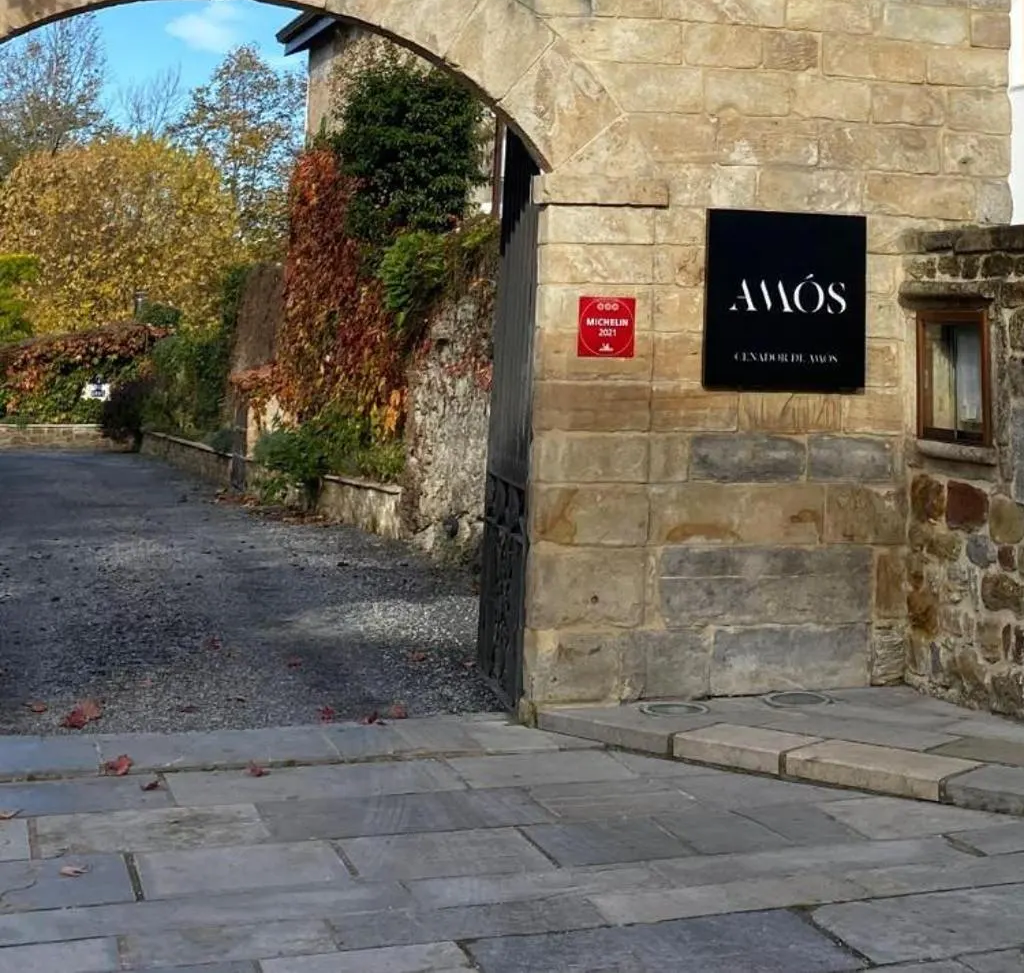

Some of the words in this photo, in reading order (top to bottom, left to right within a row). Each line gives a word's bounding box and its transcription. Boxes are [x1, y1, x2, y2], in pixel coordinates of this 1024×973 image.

[729, 274, 847, 314] AMÓS
[586, 317, 629, 327] MICHELIN
[598, 328, 617, 337] 2021
[734, 351, 789, 363] CENADOR
[791, 352, 805, 363] DE
